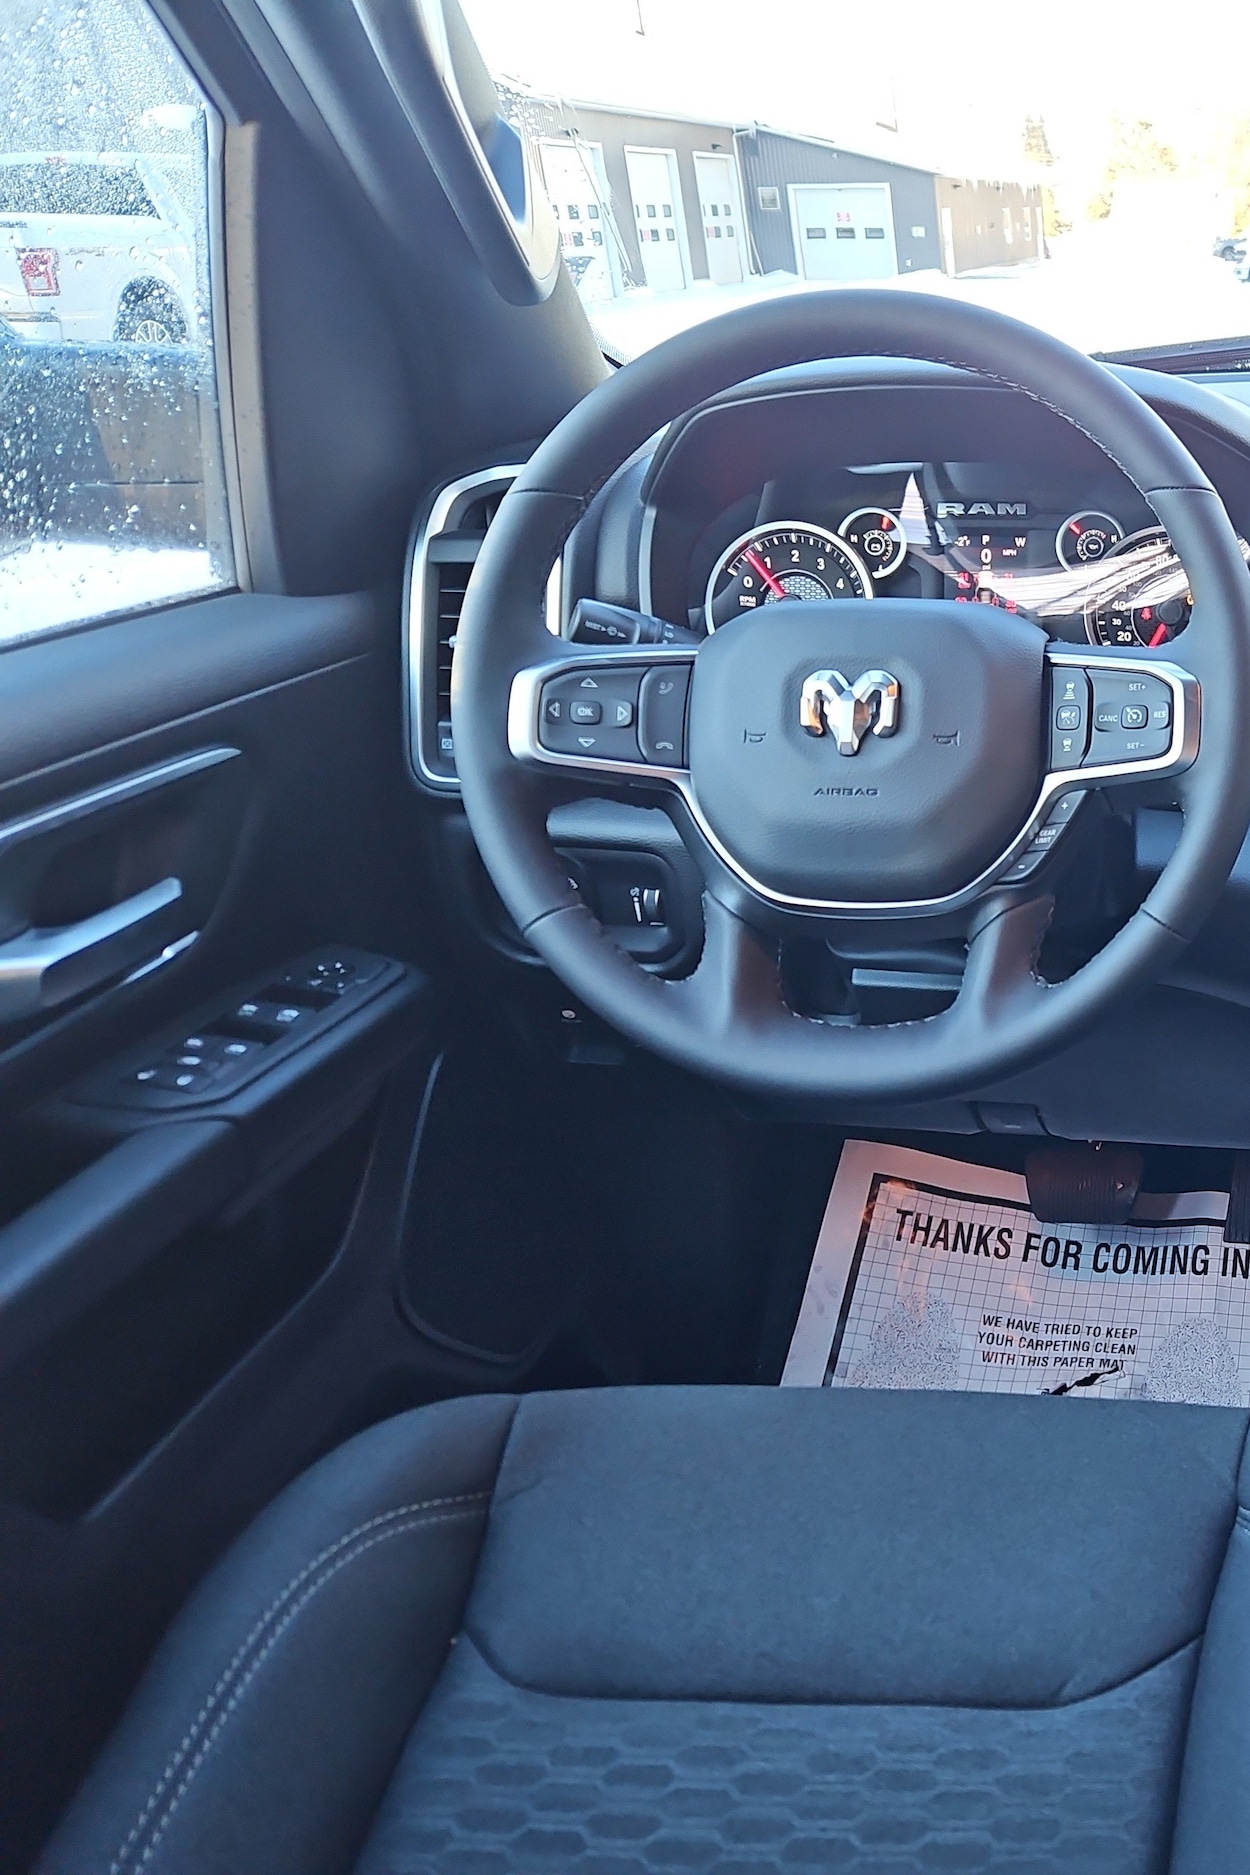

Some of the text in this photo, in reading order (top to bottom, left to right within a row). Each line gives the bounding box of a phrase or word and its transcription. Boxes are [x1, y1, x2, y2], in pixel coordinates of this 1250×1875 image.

[937, 502, 1027, 516] RAM
[850, 534, 858, 543] H
[982, 534, 990, 545] P
[1015, 537, 1026, 547] W
[1110, 533, 1118, 544] H
[790, 550, 800, 562] 2
[980, 548, 992, 564] 0
[763, 556, 772, 569] 1
[816, 557, 826, 570] 3
[742, 576, 753, 588] 0
[836, 578, 845, 590] 4
[739, 595, 757, 603] RPM
[1111, 600, 1127, 611] 40
[1111, 618, 1122, 626] 30
[1116, 631, 1132, 642] 20
[577, 706, 594, 716] OK
[1153, 711, 1166, 719] RES
[1098, 715, 1118, 723] CANC
[814, 787, 878, 796] AIRBAG
[1039, 829, 1057, 837] GEAR
[894, 1208, 1250, 1280] THANKS FOR COMING IN
[982, 1314, 1138, 1339] WE HAVE TRIED TO KEEP
[977, 1331, 1136, 1355] YOUR CARPETING CLEAN
[981, 1351, 1127, 1370] WITH THIS PAPER MAT
